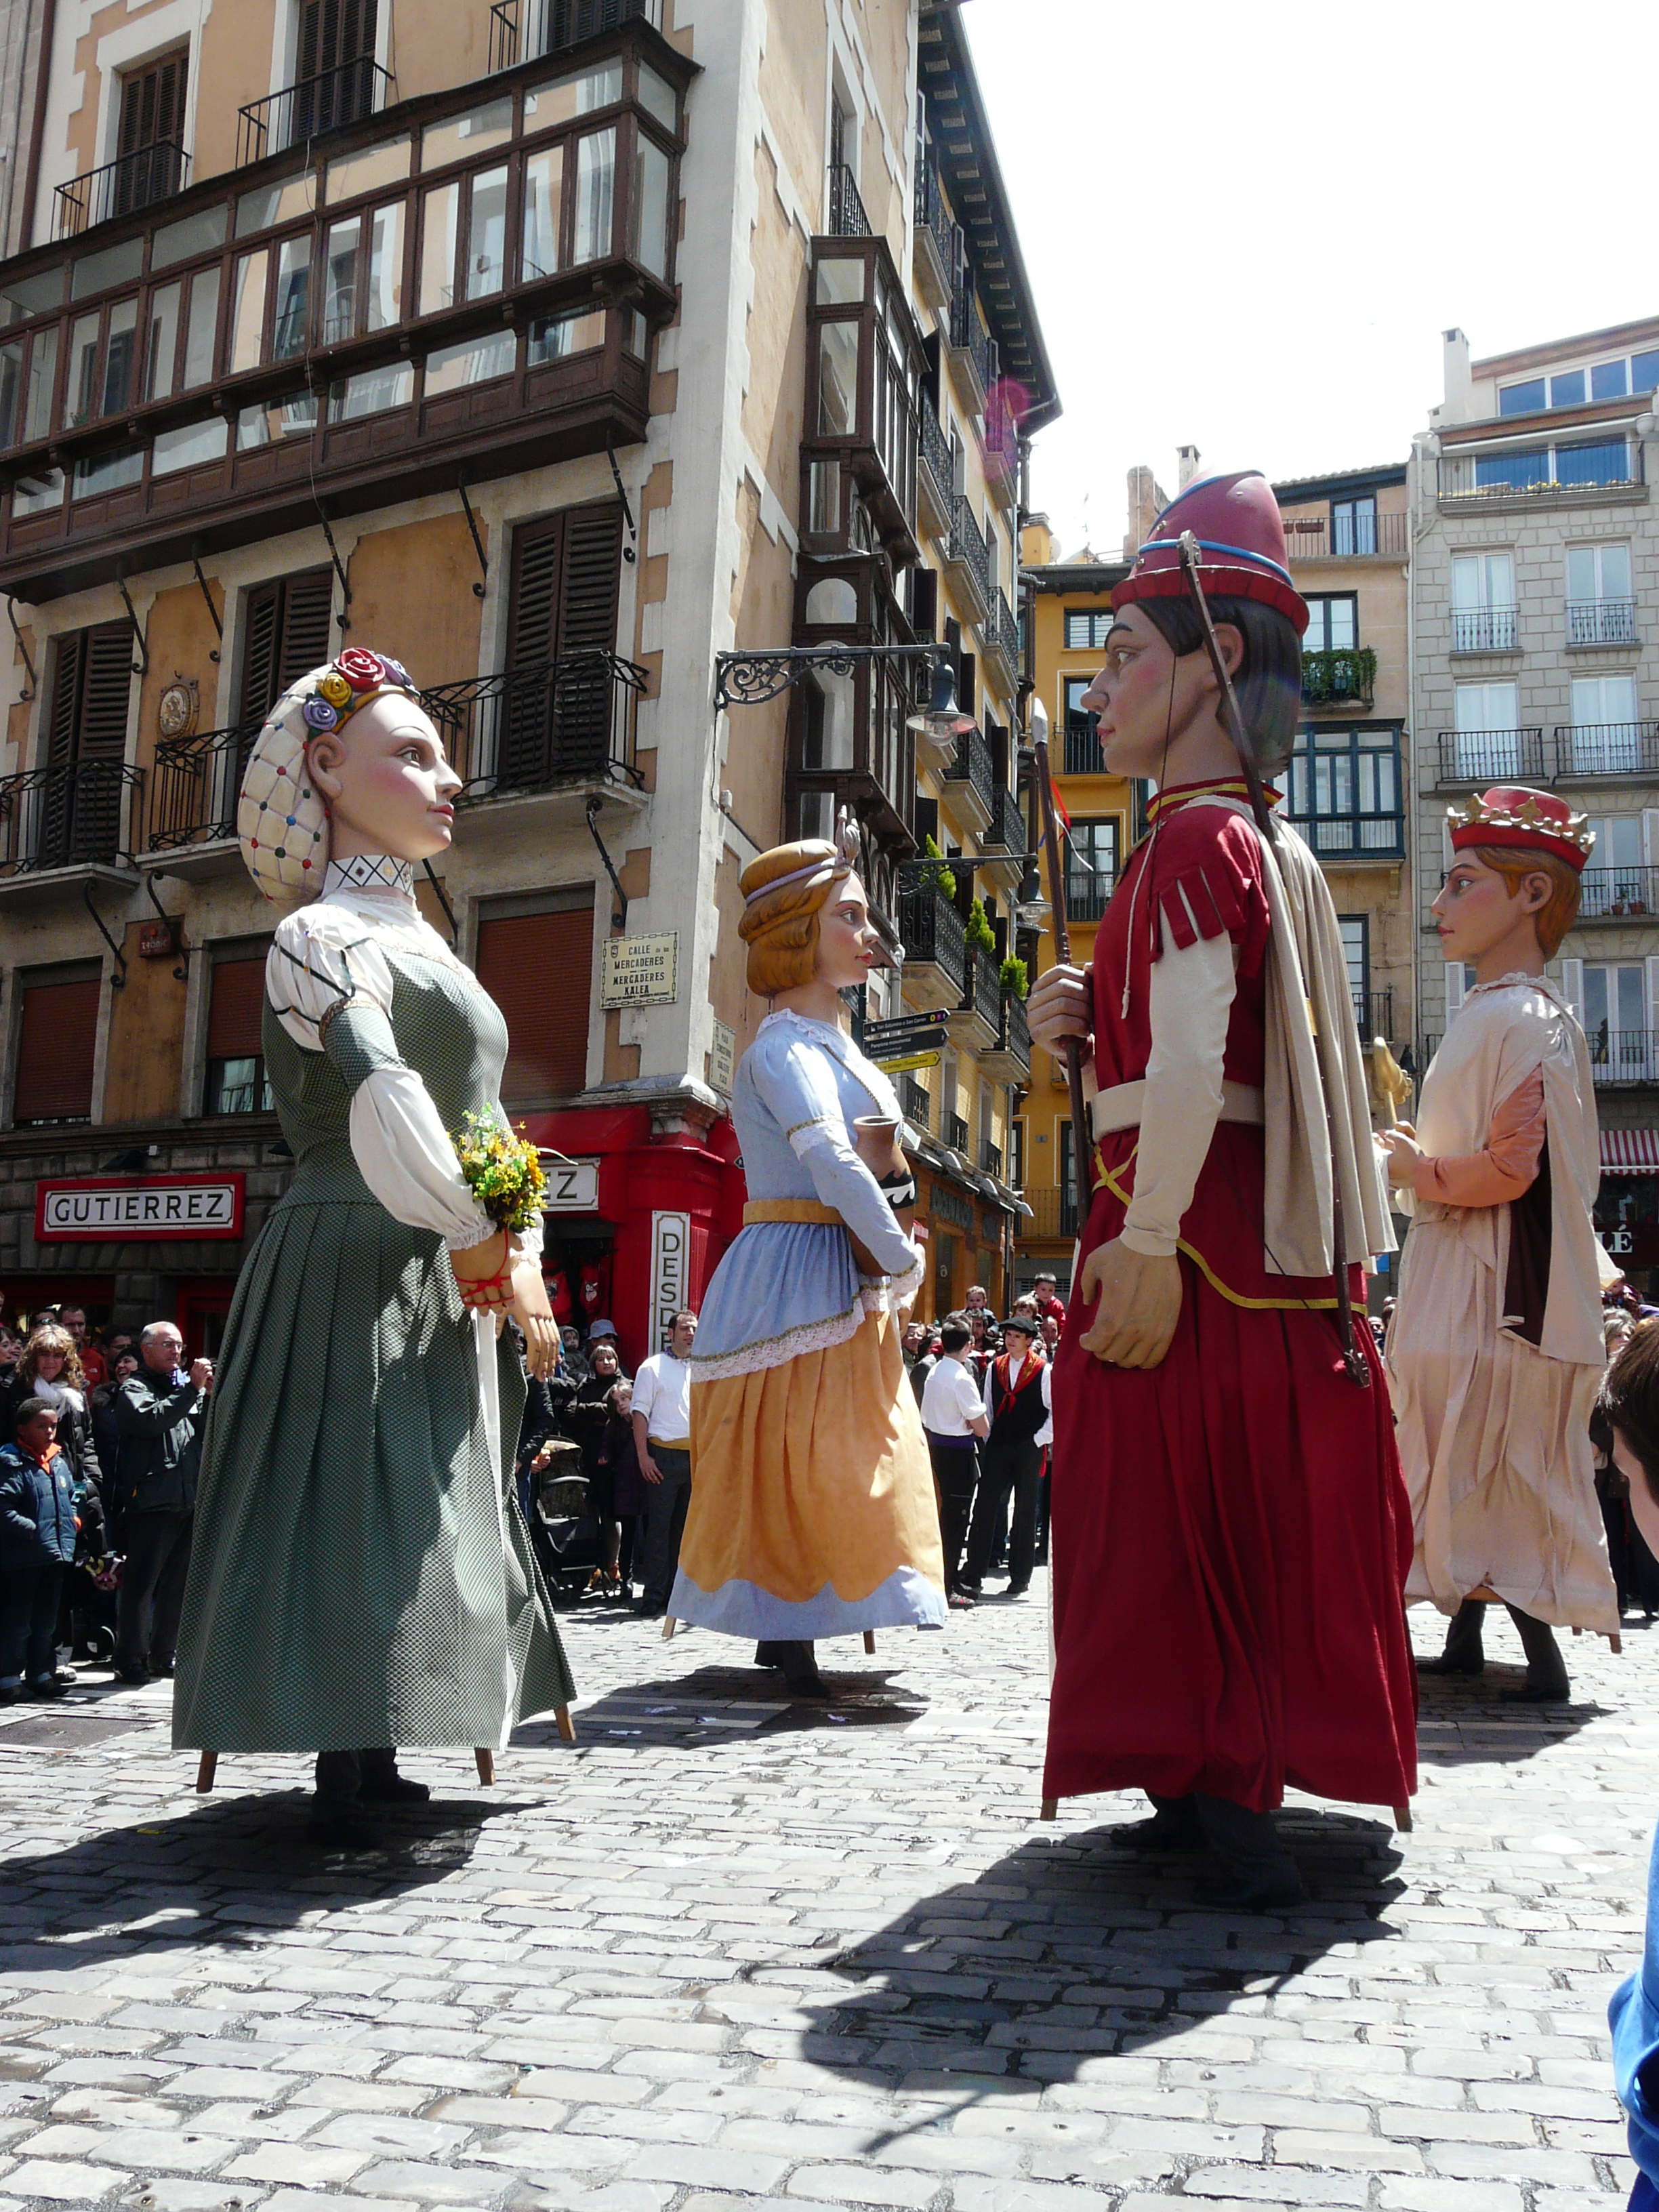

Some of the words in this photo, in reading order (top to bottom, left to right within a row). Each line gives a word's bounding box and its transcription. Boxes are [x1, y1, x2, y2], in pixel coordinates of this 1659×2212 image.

[628, 945, 651, 956] CALLE
[614, 956, 664, 970] MERCADERES
[613, 972, 665, 985] MERCADERES
[624, 985, 649, 996] KALEA
[54, 1193, 224, 1222] GUTIERREZ
